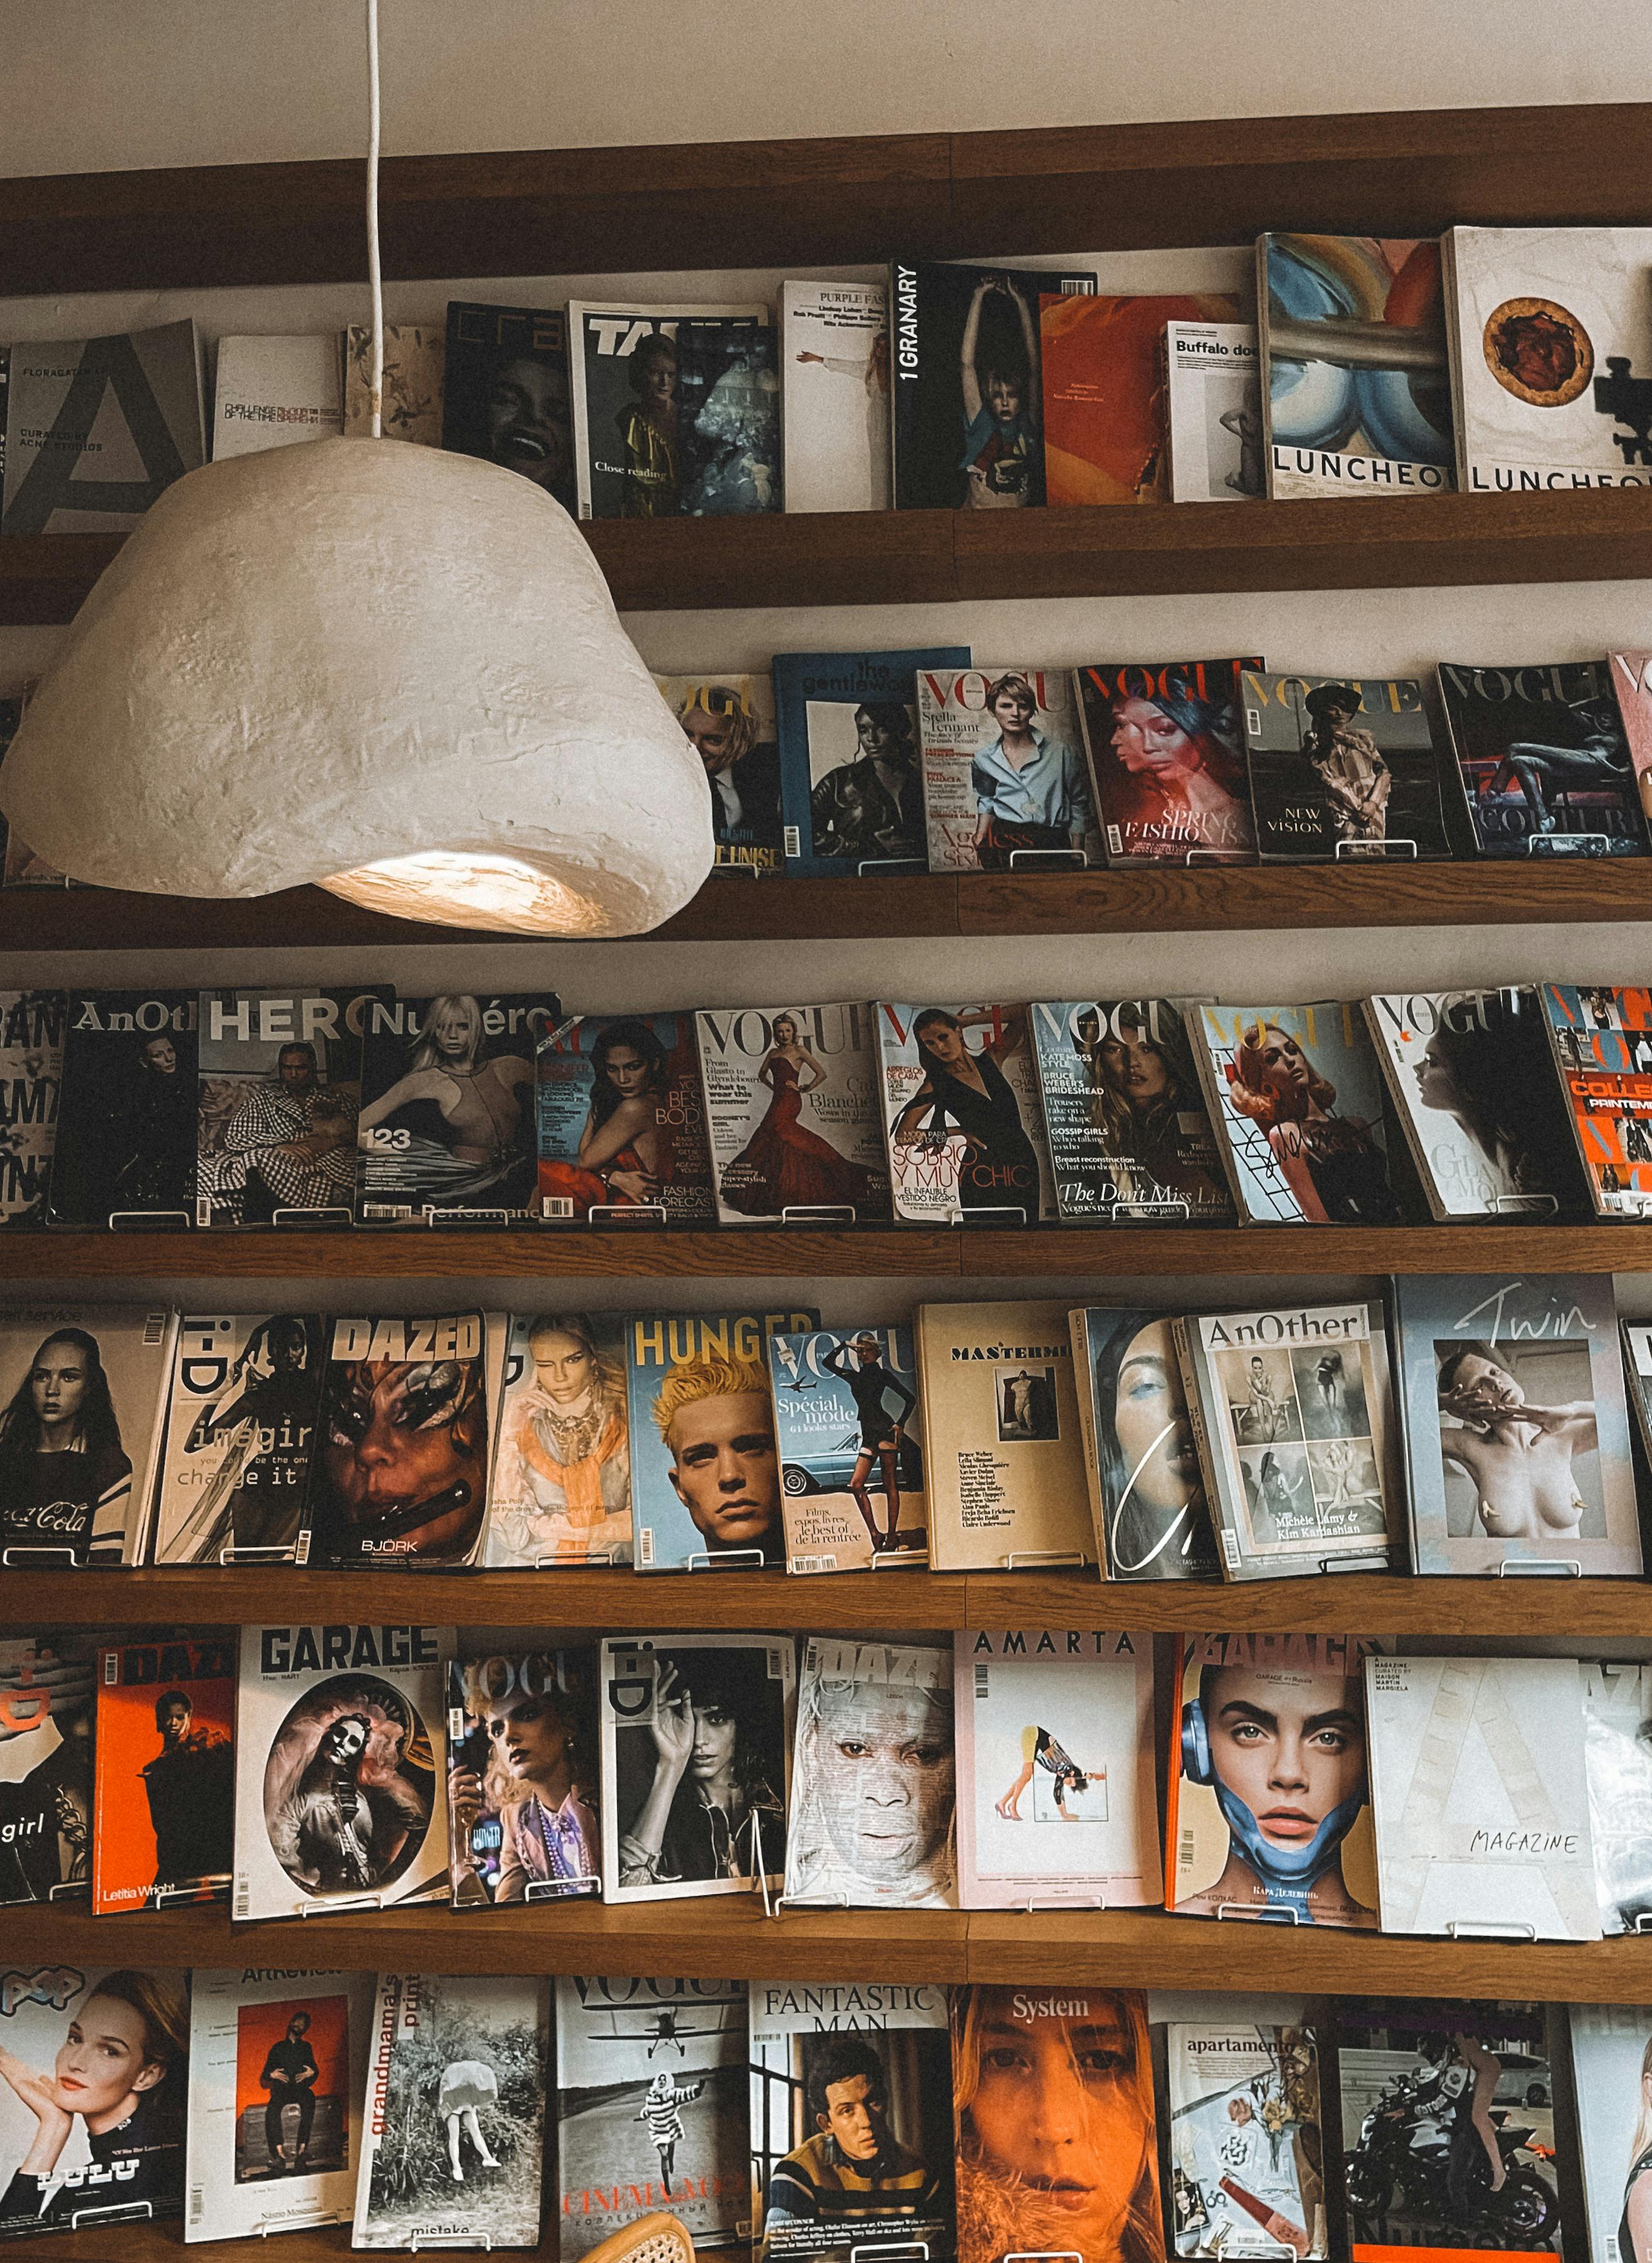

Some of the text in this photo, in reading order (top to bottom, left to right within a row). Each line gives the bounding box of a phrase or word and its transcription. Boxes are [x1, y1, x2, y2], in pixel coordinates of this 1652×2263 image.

[820, 293, 862, 303] PURPLE
[898, 265, 919, 381] 1 GRANARY
[1176, 341, 1228, 355] Buffalo
[594, 461, 668, 481] Close reading
[1473, 466, 1652, 491] LUNCHEO
[1247, 673, 1423, 713] VOUE
[922, 711, 956, 723] Stella
[931, 720, 980, 732] Tennant
[1162, 808, 1237, 830] SPRING
[1285, 808, 1320, 819] NEW
[371, 999, 552, 1036] Nuéro
[705, 1058, 729, 1067] From
[1041, 1053, 1092, 1062] KATE MOSS
[1044, 1072, 1075, 1080] BRUCE
[1044, 1080, 1085, 1088] WEBER'S
[1045, 1087, 1105, 1095] BRIDESHEAD
[1046, 1096, 1083, 1106] Trousers
[1068, 1114, 1092, 1125] shape
[361, 1128, 412, 1149] 123
[1063, 1142, 1080, 1151] who
[1078, 1135, 1105, 1144] talking
[893, 1144, 978, 1166] SOBRIO
[1054, 1155, 1135, 1164] Breast reconstruction
[893, 1164, 1031, 1188] Y MUY CHIC
[1056, 1163, 1146, 1173] What you should know
[662, 1185, 714, 1197] FASHION
[1059, 1182, 1095, 1202] The
[1100, 1175, 1146, 1202] Don't
[1151, 1185, 1193, 1203] Miss
[654, 1196, 715, 1208] FORECAST
[897, 1194, 927, 1202] VESTIDO
[1061, 1202, 1097, 1215] Vogue's
[1453, 1281, 1597, 1349] Twin
[331, 1315, 481, 1362] DAZED
[1208, 1312, 1359, 1349] AnOther
[778, 1394, 838, 1418] Spécial
[805, 1405, 855, 1423] mode
[802, 1423, 828, 1433] looks
[255, 1456, 266, 1464] be
[272, 1456, 288, 1464] the
[177, 1467, 297, 1489] change it
[1275, 1510, 1358, 1528] Michèle Lamy &
[796, 1530, 862, 1545] de la rentrée
[801, 1523, 850, 1536] le best of
[1276, 1524, 1361, 1540] Kim Kardashian
[361, 1538, 418, 1552] BJÖRK
[261, 1625, 439, 1674] GARAGE
[973, 1631, 1135, 1654] AMARTA
[1, 1813, 44, 1843] girl
[103, 1883, 175, 1902] Letitia Wright
[405, 1973, 420, 2028] print
[763, 1985, 937, 2016] FANTASTIC
[1012, 1993, 1089, 2024] System
[812, 2013, 888, 2034] MAN
[371, 1973, 399, 2135] grandmama's
[38, 2159, 139, 2191] LULU
[411, 2225, 469, 2237] mistake
